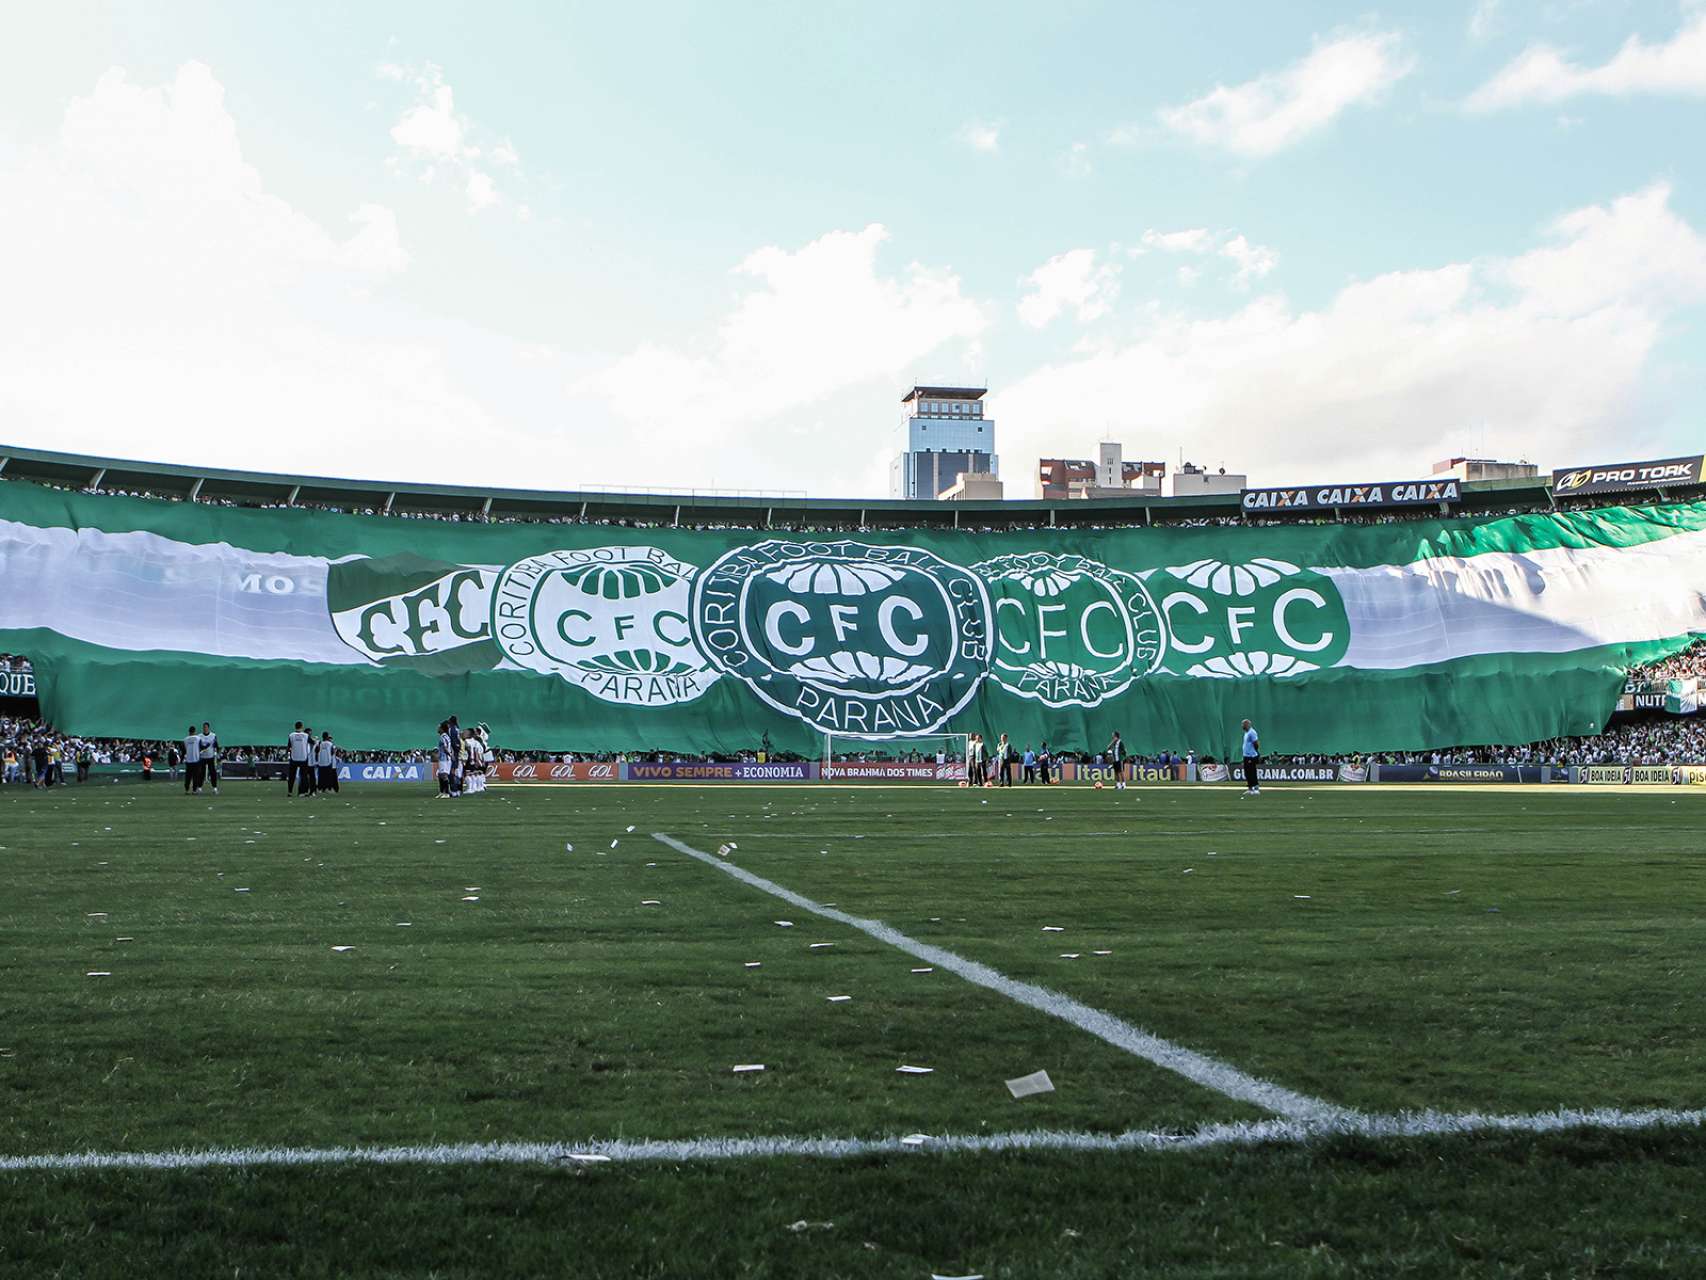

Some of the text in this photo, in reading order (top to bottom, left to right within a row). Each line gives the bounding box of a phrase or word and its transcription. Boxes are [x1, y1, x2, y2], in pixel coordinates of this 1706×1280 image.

[1592, 469, 1636, 483] PRO
[1638, 463, 1693, 480] TORK
[1243, 483, 1458, 508] CAIXA CAIXA CAIXA
[356, 570, 490, 653] CFC
[500, 557, 552, 656] CORITIBA
[552, 548, 626, 565] FOOT
[705, 543, 986, 667] CORITIBA FOOT BALL CLUB
[1128, 593, 1158, 660] CLUB
[796, 683, 944, 732] PARANÁ
[362, 765, 419, 779] CAIXA
[512, 764, 538, 778] GOL
[550, 764, 576, 778] GOL
[588, 764, 614, 778] GOL
[634, 767, 672, 777] VIVO
[676, 766, 732, 778] SEMPRE
[822, 767, 846, 777] NOVA
[848, 767, 886, 777] BRAHMA
[887, 767, 905, 777] DOS
[907, 767, 933, 777] TIMES
[1077, 764, 1115, 781] Itaú
[1132, 764, 1172, 781] Itaú
[1635, 770, 1649, 782] BOA
[1650, 770, 1669, 782] IDEIA
